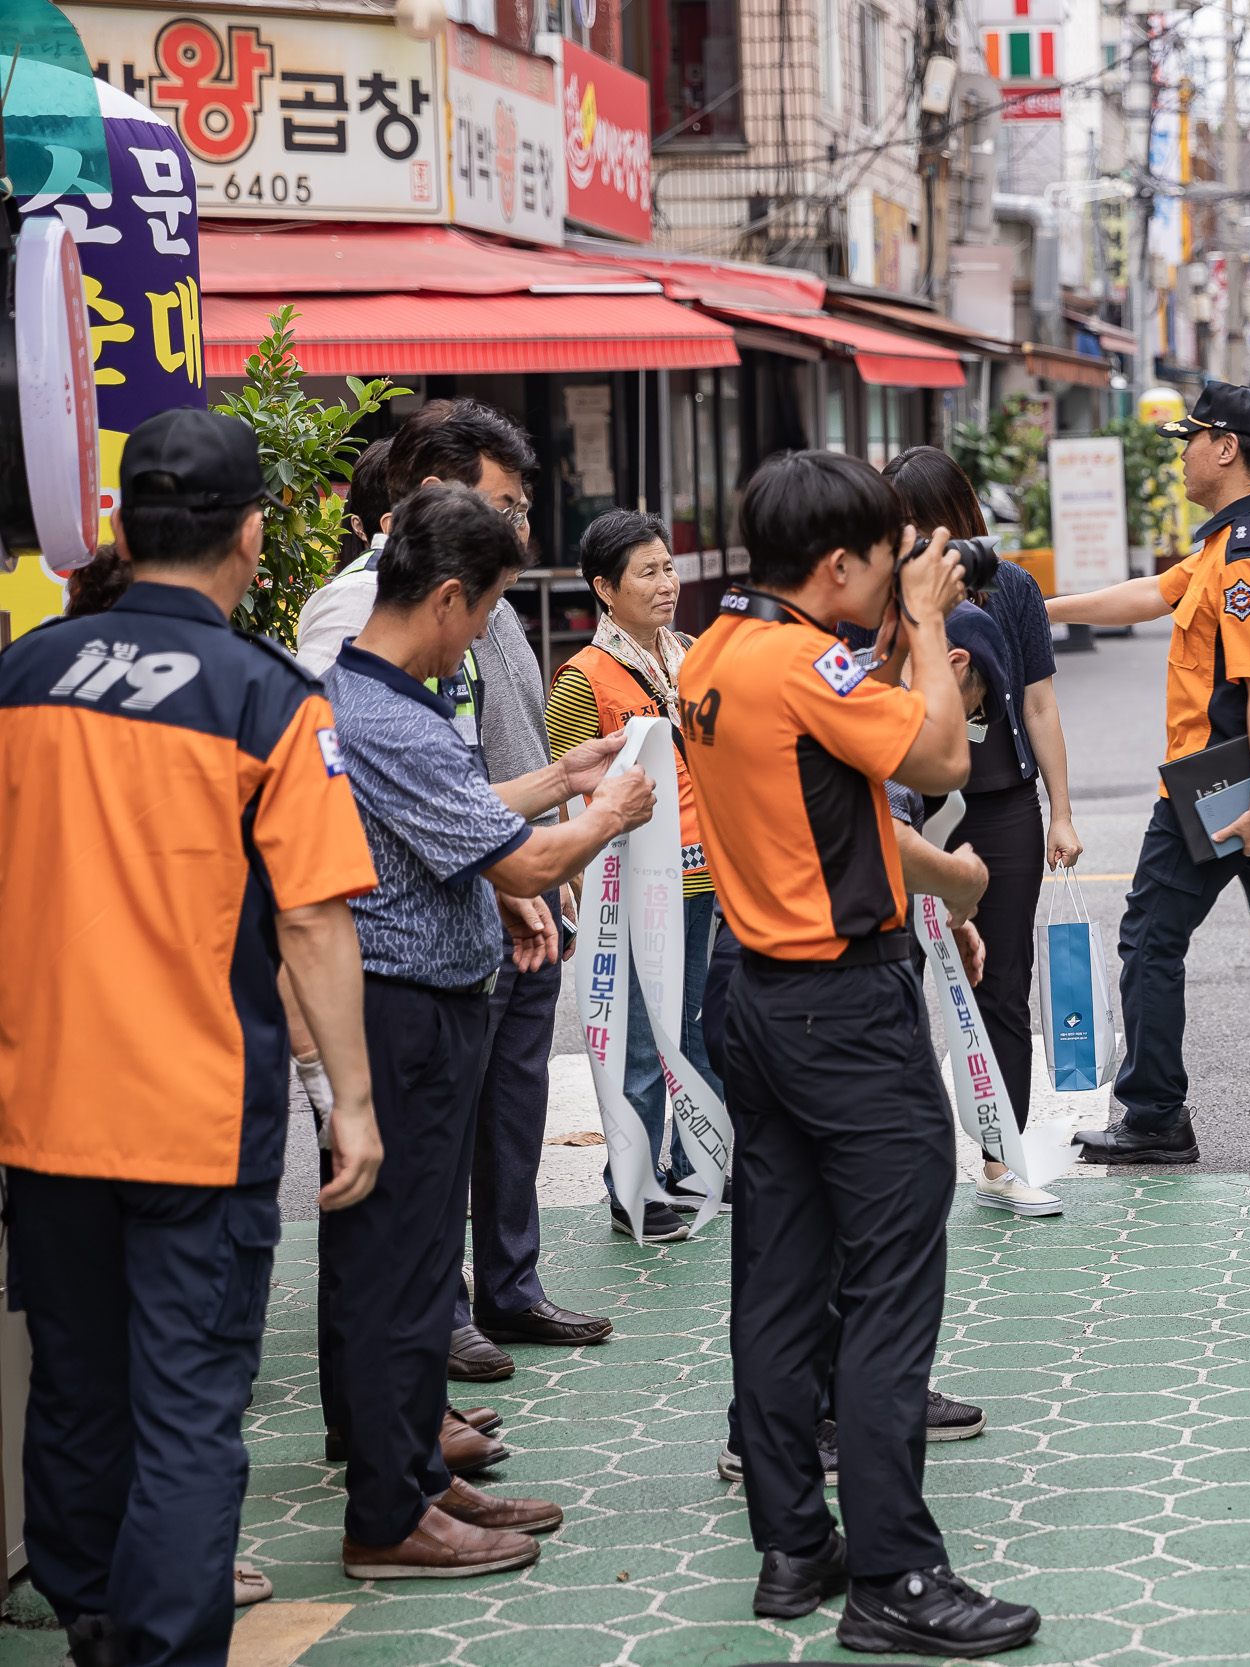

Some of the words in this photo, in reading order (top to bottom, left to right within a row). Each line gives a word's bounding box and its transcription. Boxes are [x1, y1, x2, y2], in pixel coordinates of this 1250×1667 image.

[49, 651, 201, 712] 119
[80, 639, 140, 662] 소방
[597, 855, 621, 949] 화재에는
[588, 952, 617, 1022] 예보가
[949, 983, 980, 1050] 예보가
[967, 1052, 996, 1101] 따로
